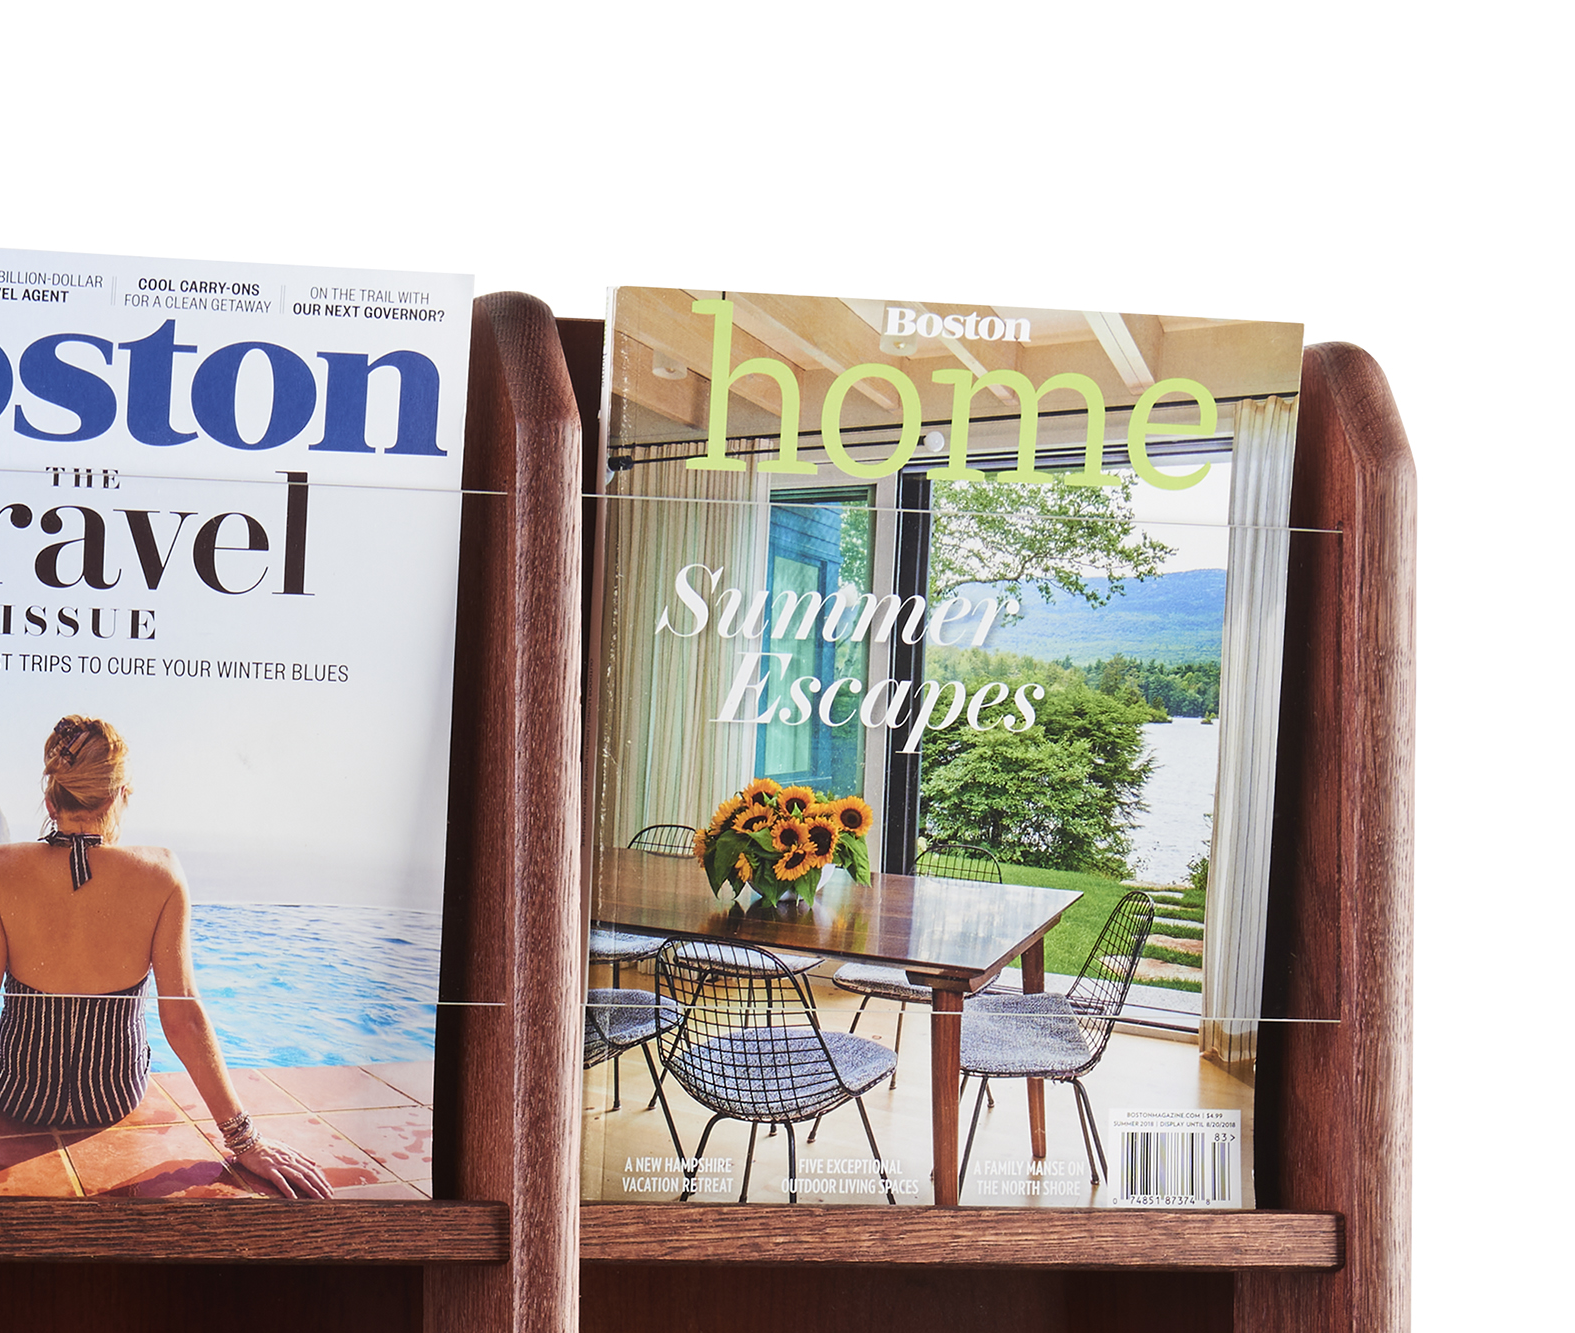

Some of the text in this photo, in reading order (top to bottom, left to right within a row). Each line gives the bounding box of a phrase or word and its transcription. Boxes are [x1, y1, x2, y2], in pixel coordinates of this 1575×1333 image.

[138, 278, 260, 296] COOL CARRY-ONS
[884, 307, 1031, 343] Boston
[686, 299, 1217, 491] home
[46, 466, 120, 489] THE
[656, 563, 1020, 647] Summer
[0, 604, 156, 640] ISSUE
[20, 654, 71, 673] TRIPS
[78, 655, 102, 674] TO
[108, 656, 156, 676] CURE
[162, 658, 211, 678] YOUR
[216, 661, 285, 680] WINTER
[292, 663, 349, 682] BLUES
[709, 650, 1045, 754] Escapes
[625, 1157, 732, 1173] A NEW HAMPSHIRE
[623, 1177, 733, 1193] VACATION RETREAT
[782, 1179, 919, 1195] OUTDOOR LIVING SPACES
